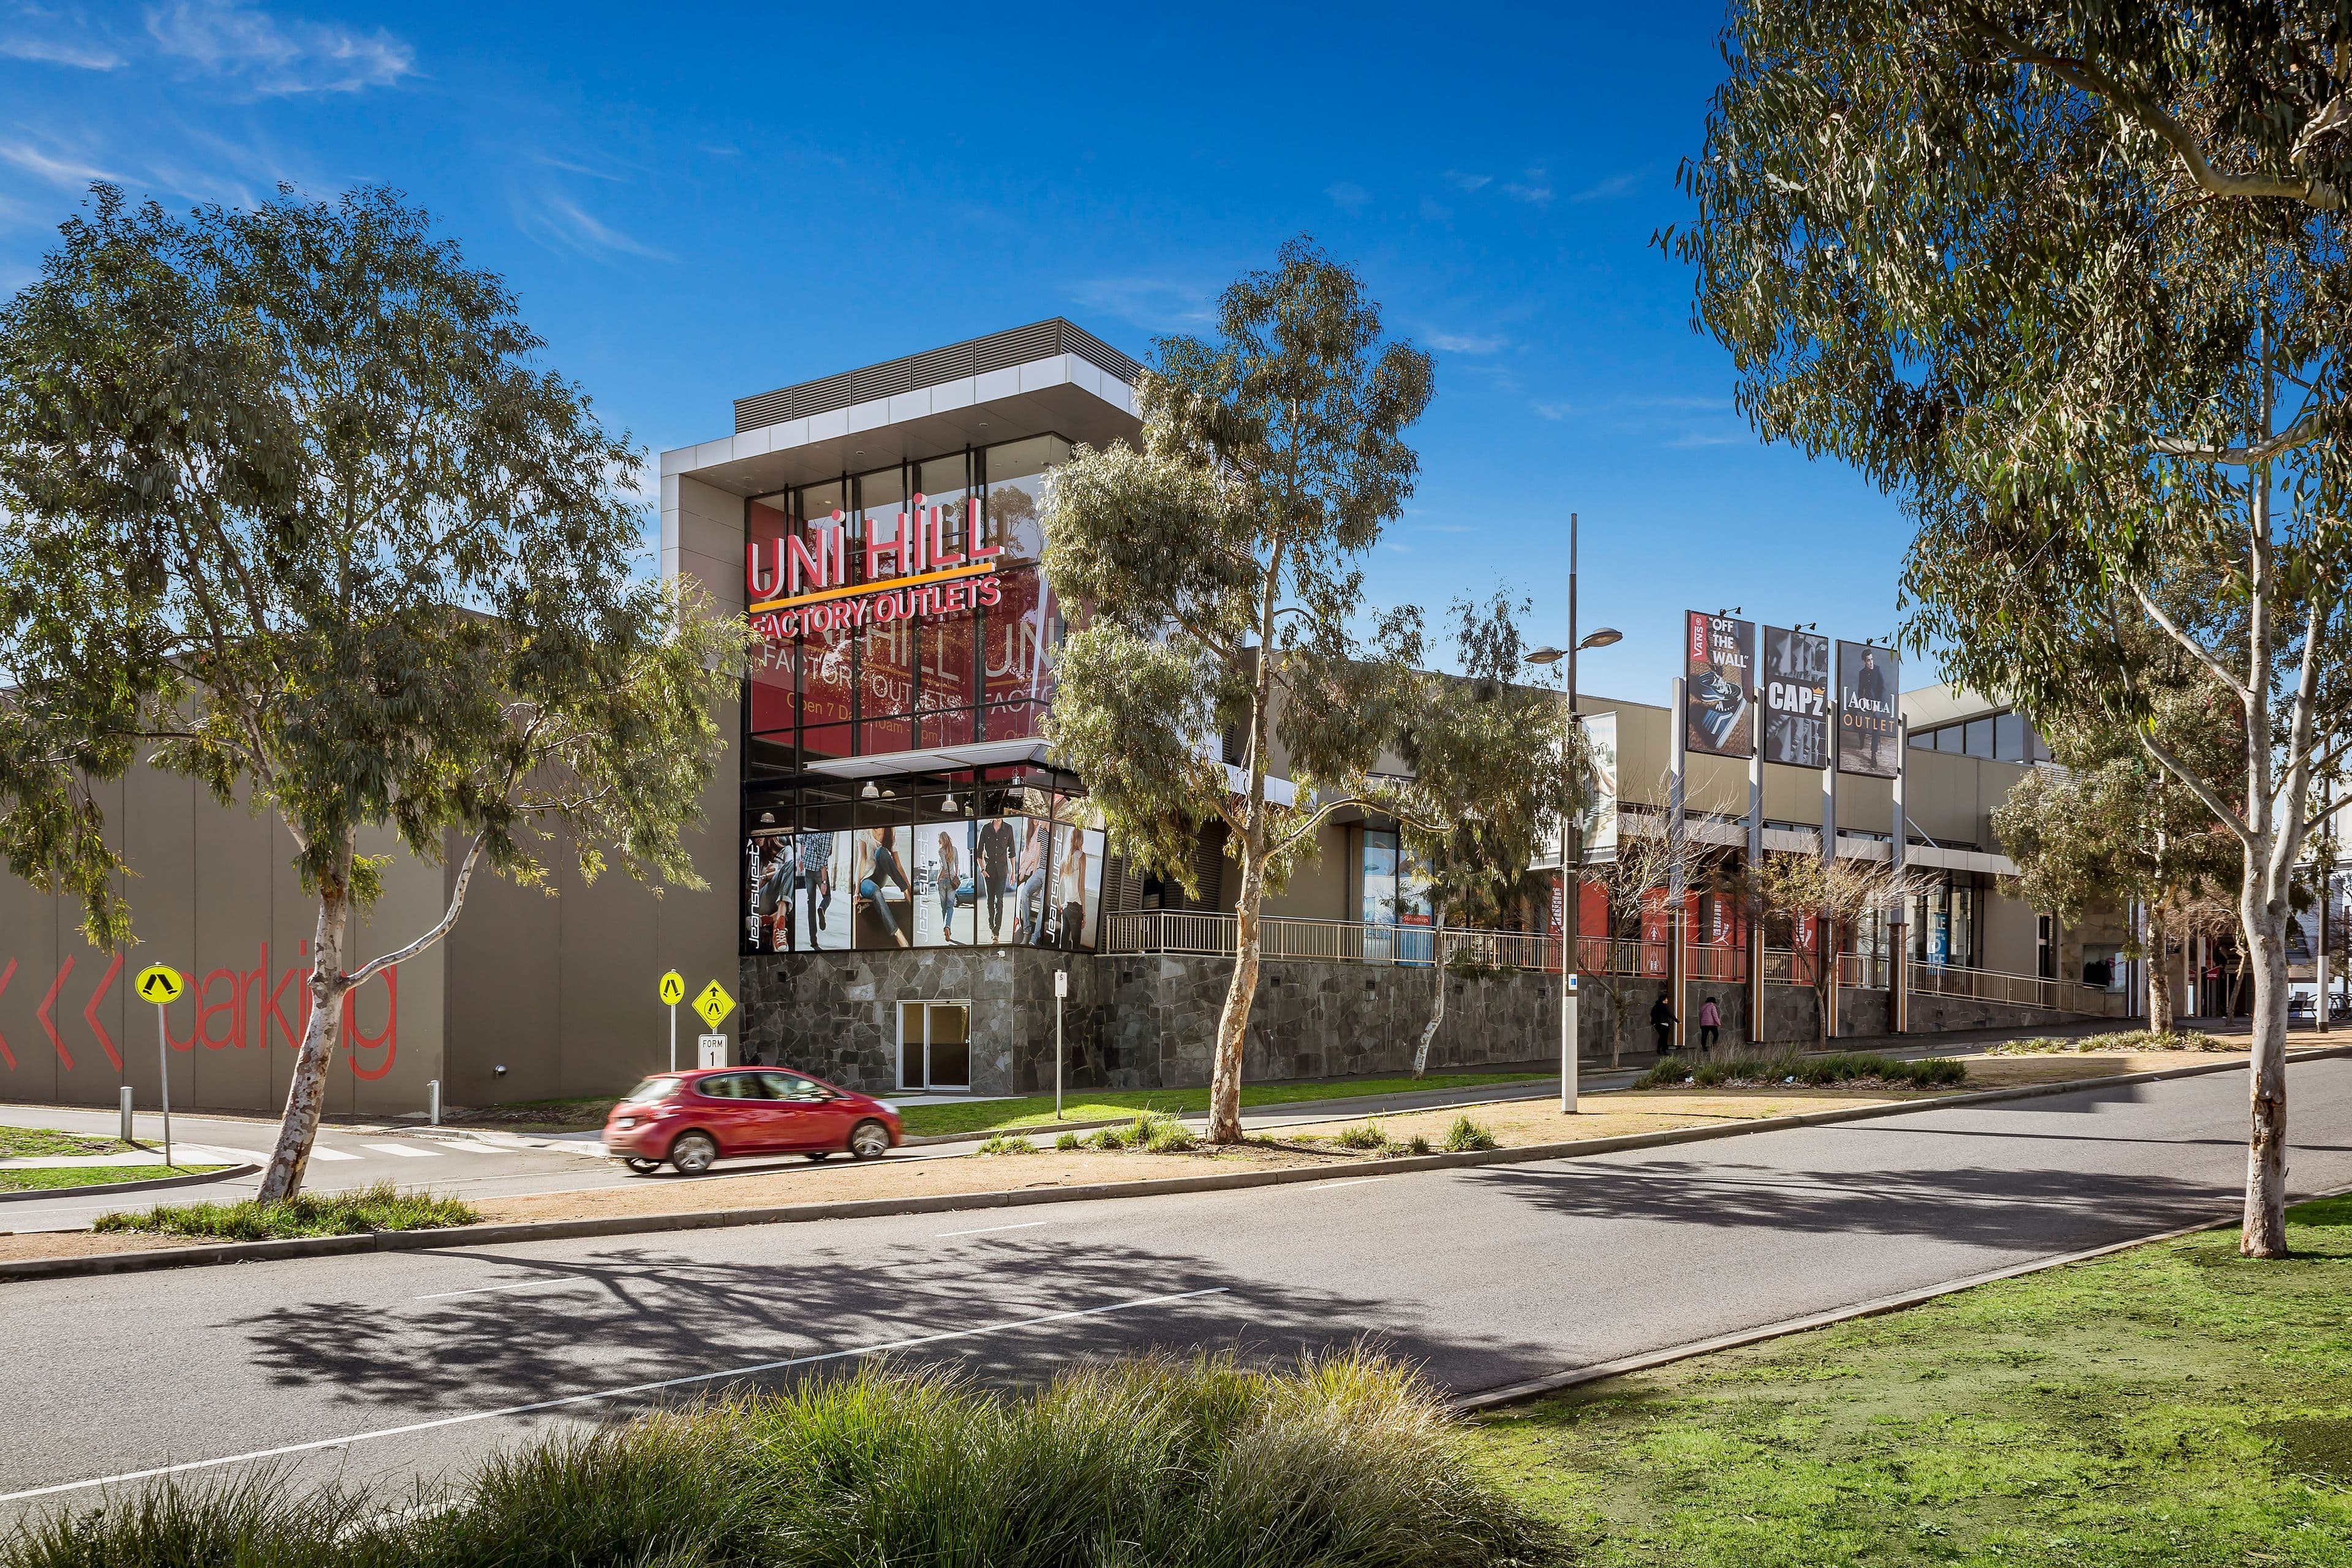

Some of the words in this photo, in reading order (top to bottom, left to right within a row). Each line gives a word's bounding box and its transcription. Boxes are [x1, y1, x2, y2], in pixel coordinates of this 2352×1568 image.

[750, 599, 867, 641] FACTORY
[874, 576, 1001, 623] OUTLETS
[986, 617, 1054, 677] UN
[1713, 634, 1734, 649] THE
[872, 674, 963, 717] OUTETS
[827, 703, 834, 717] 7
[839, 705, 868, 726] Das
[921, 729, 938, 743] pm
[1844, 714, 1894, 733] OUTLET
[748, 844, 760, 949] Jeanswest
[917, 831, 929, 942] Jeanswest
[1046, 830, 1063, 943] Jeanswest
[703, 1039, 723, 1048] FORM
[710, 1051, 714, 1066] 1
